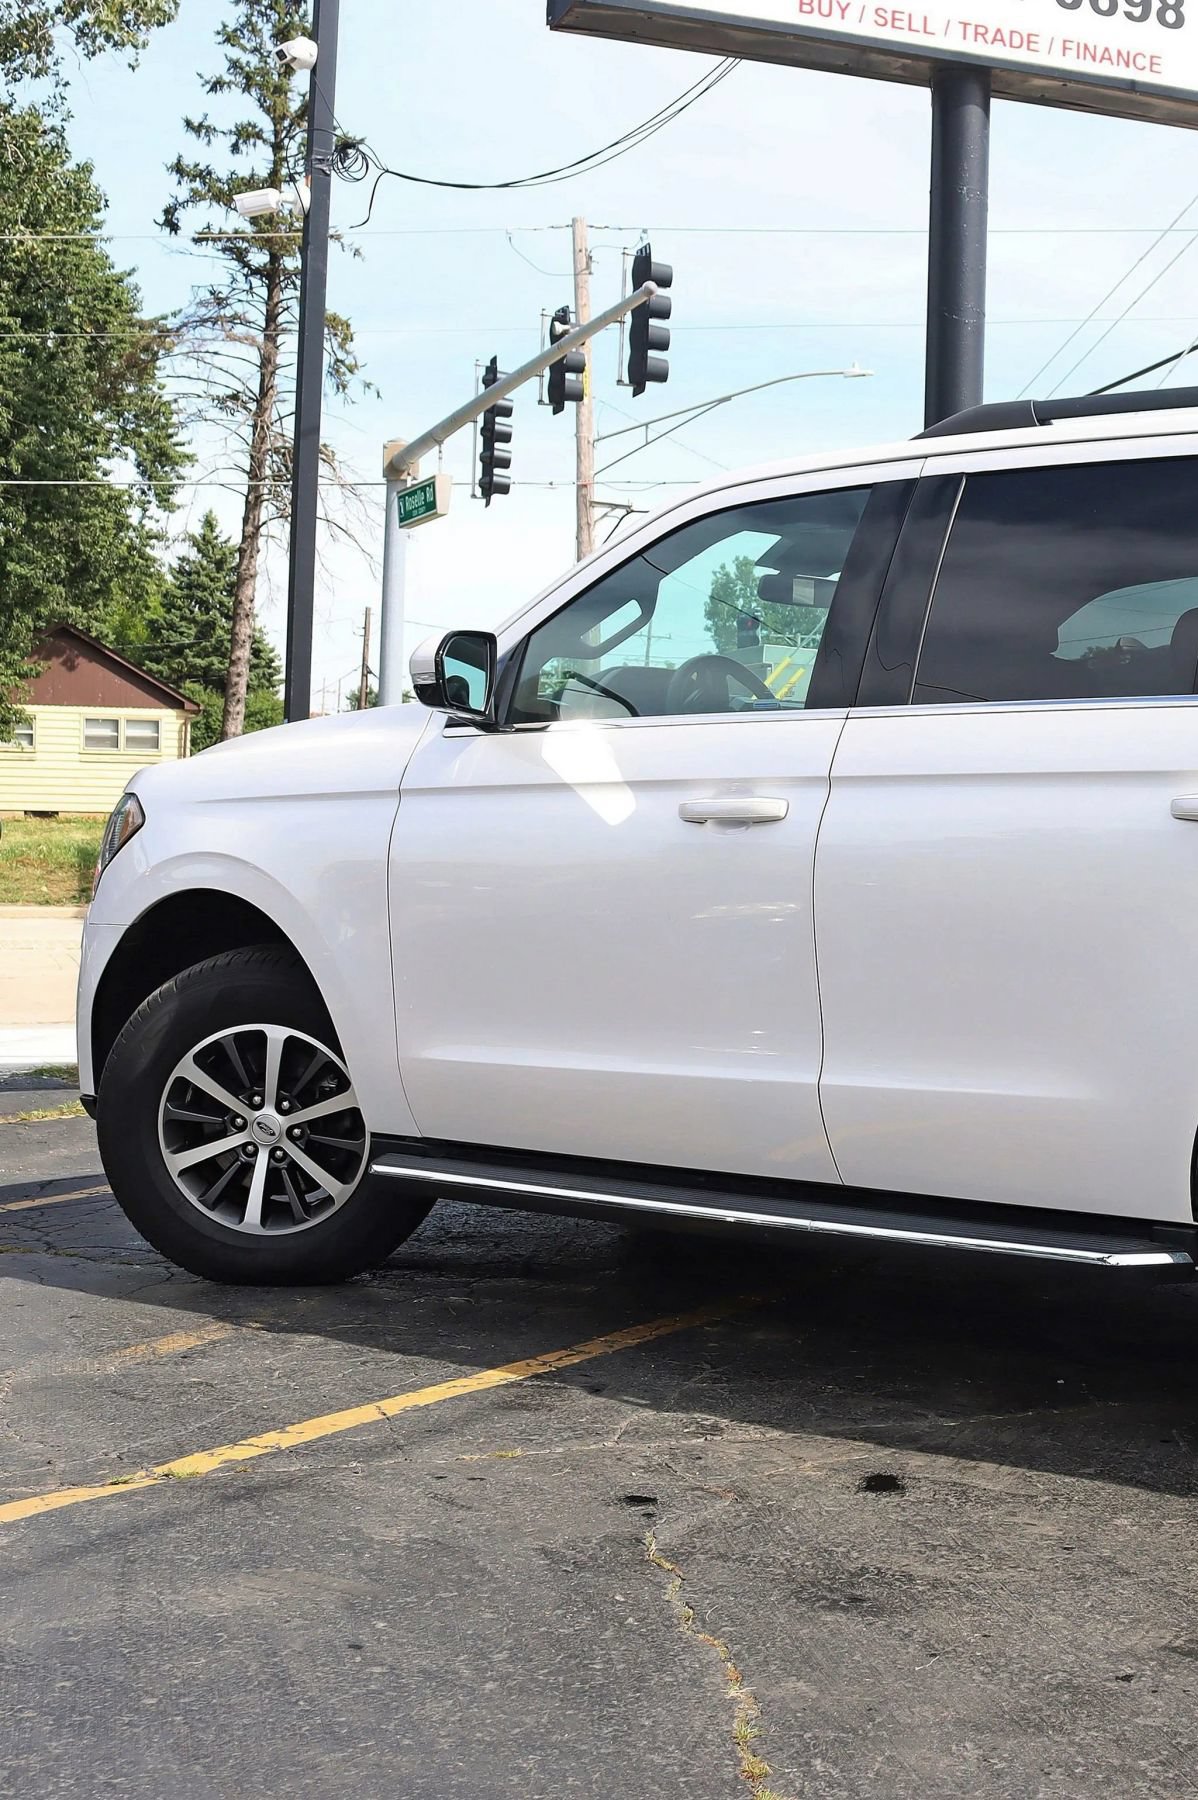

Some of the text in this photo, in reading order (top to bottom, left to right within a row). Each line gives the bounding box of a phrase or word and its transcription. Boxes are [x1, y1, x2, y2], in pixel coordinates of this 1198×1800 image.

[798, 0, 850, 20] BUY
[873, 7, 936, 36] SELL
[958, 21, 1040, 53] TRADE
[1061, 39, 1163, 74] FINANCE
[405, 489, 425, 511] Roselle
[426, 483, 434, 503] Rd
